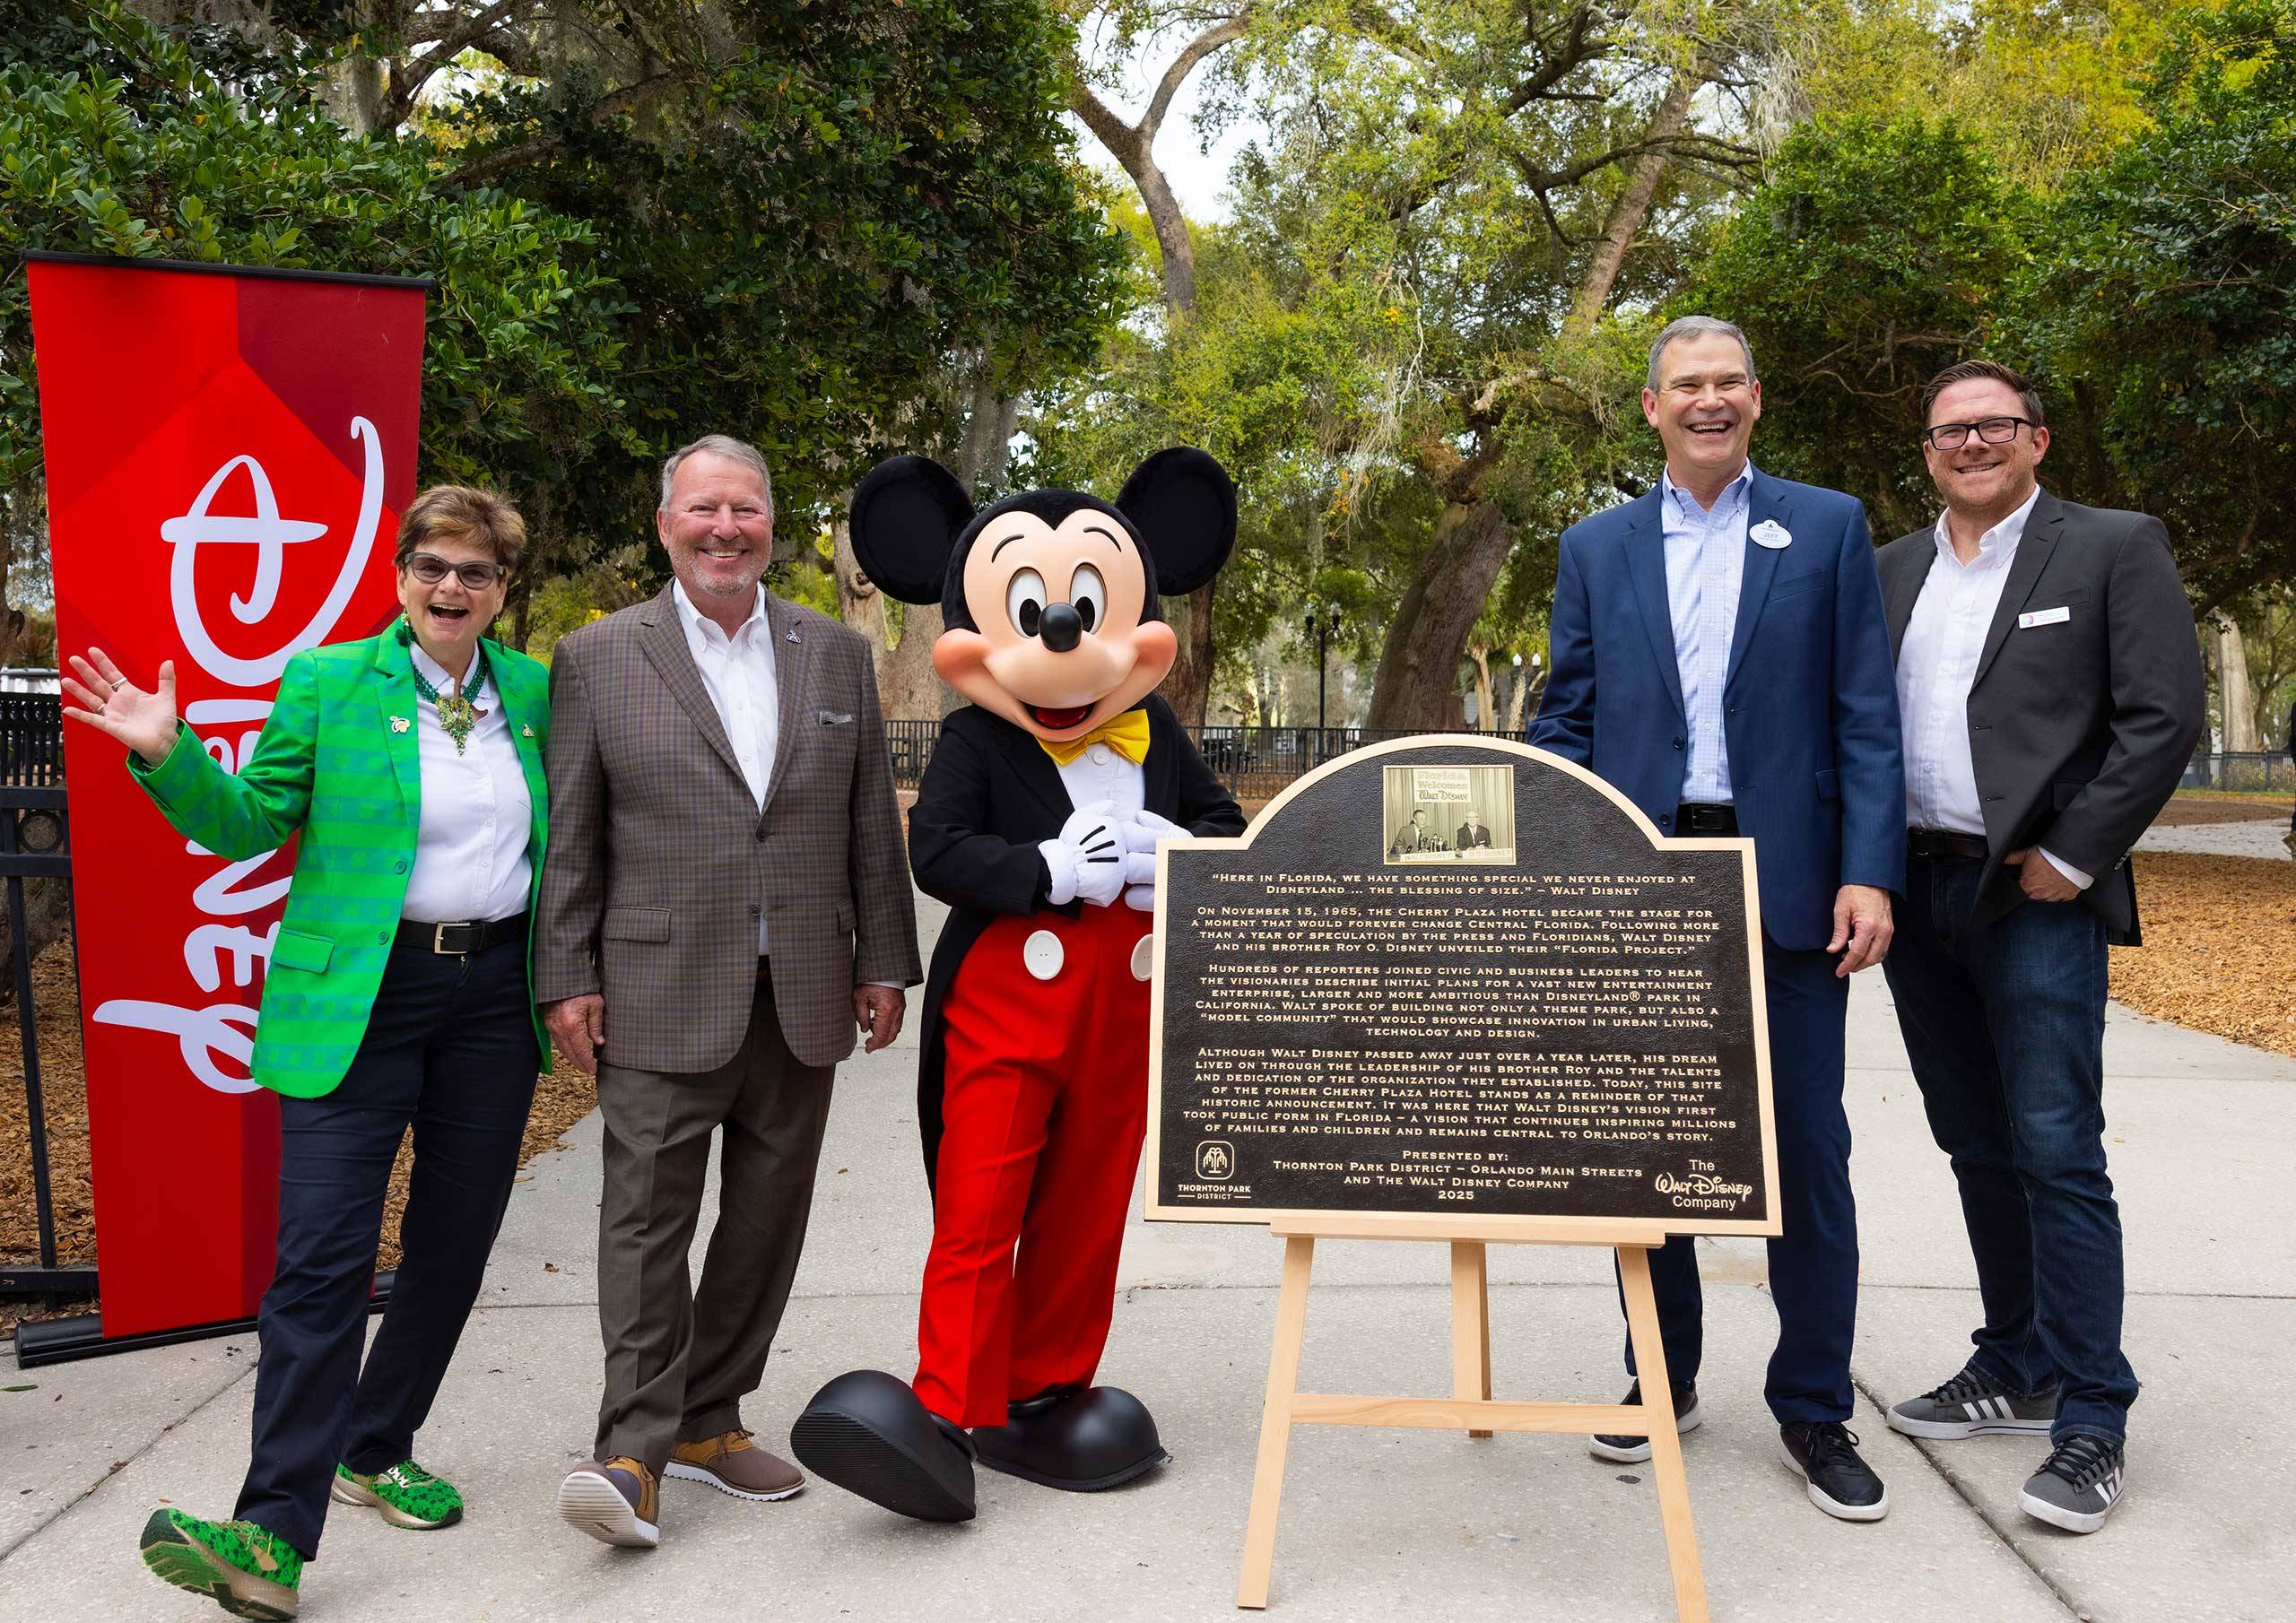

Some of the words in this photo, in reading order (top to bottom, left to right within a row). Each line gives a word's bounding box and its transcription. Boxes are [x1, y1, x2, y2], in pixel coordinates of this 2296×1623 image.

[1689, 1159, 1715, 1171] The
[1178, 1184, 1226, 1193] THORNTON
[1228, 1185, 1251, 1193] PARK
[1673, 1196, 1736, 1211] Company
